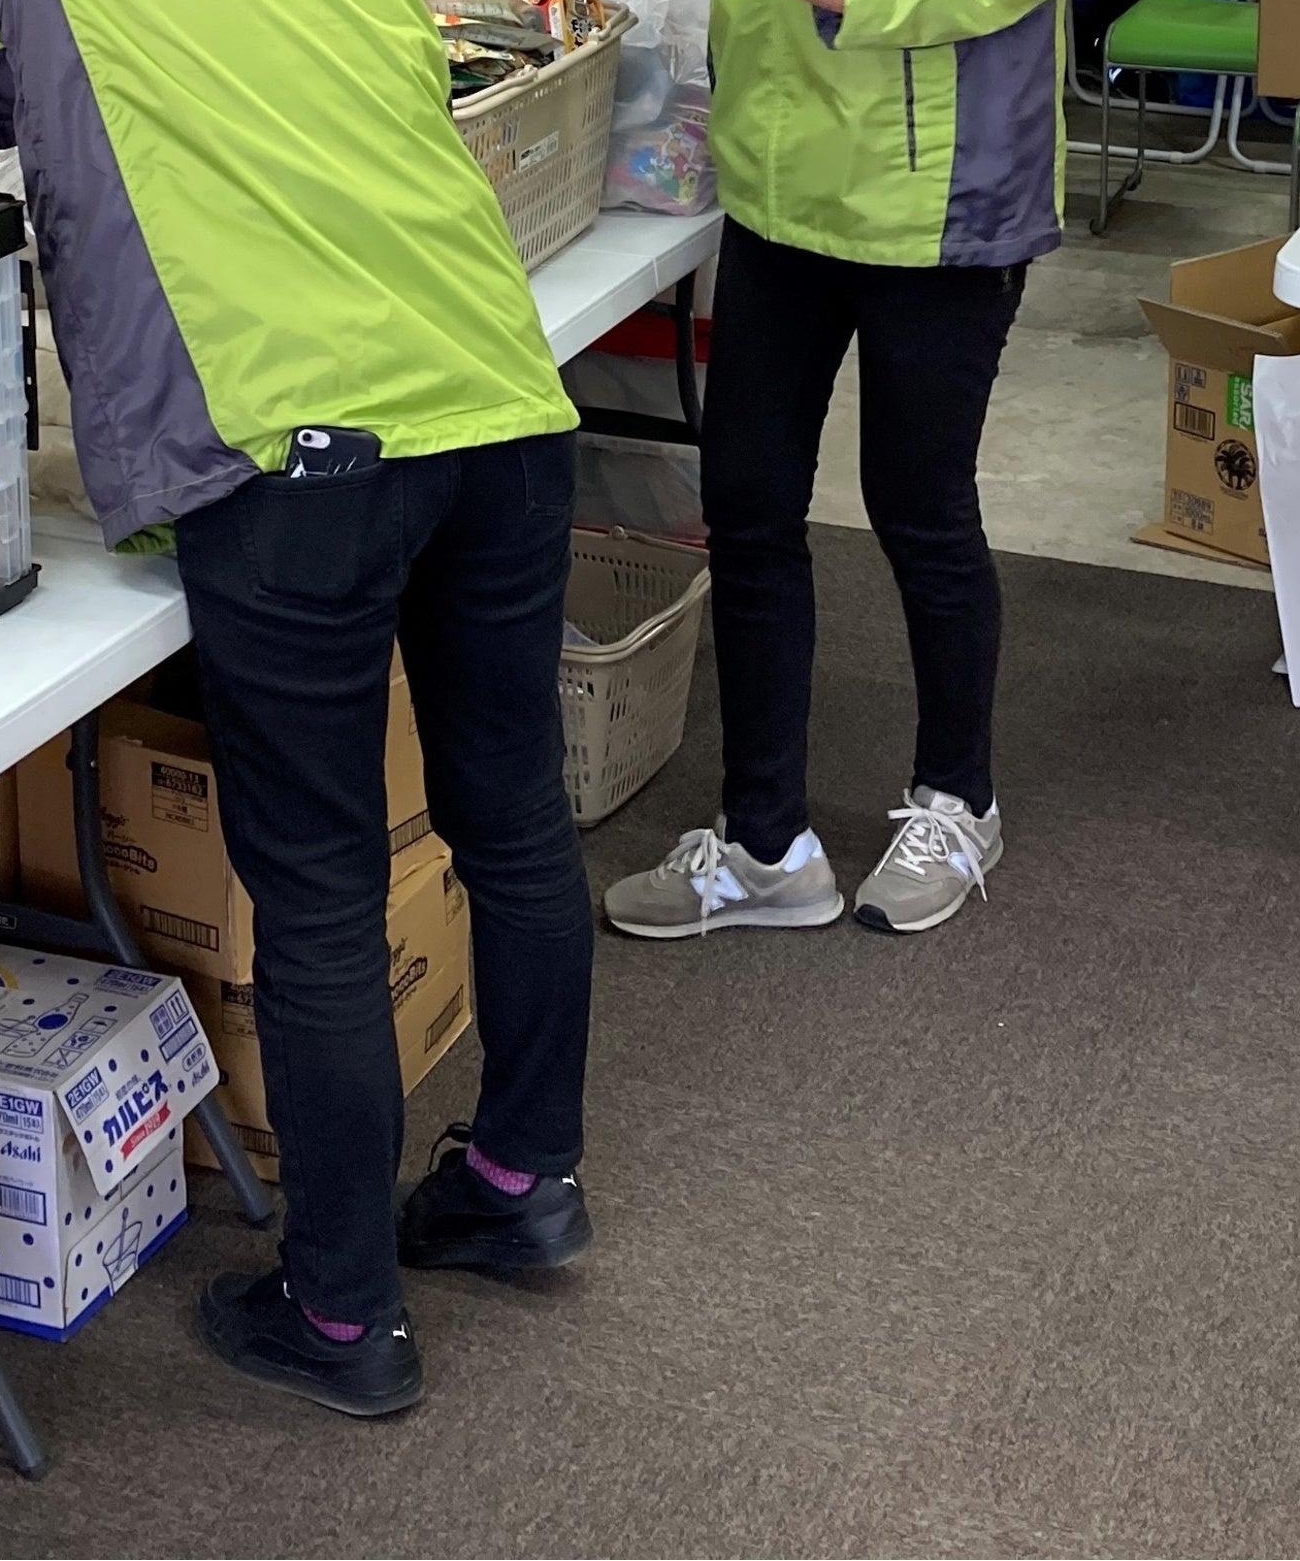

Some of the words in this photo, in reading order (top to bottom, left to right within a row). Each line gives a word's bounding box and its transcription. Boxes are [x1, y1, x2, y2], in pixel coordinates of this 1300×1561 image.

[65, 1071, 101, 1110] 2E1GW
[101, 1069, 170, 1147] カルピス
[0, 1140, 42, 1163] Asahi
